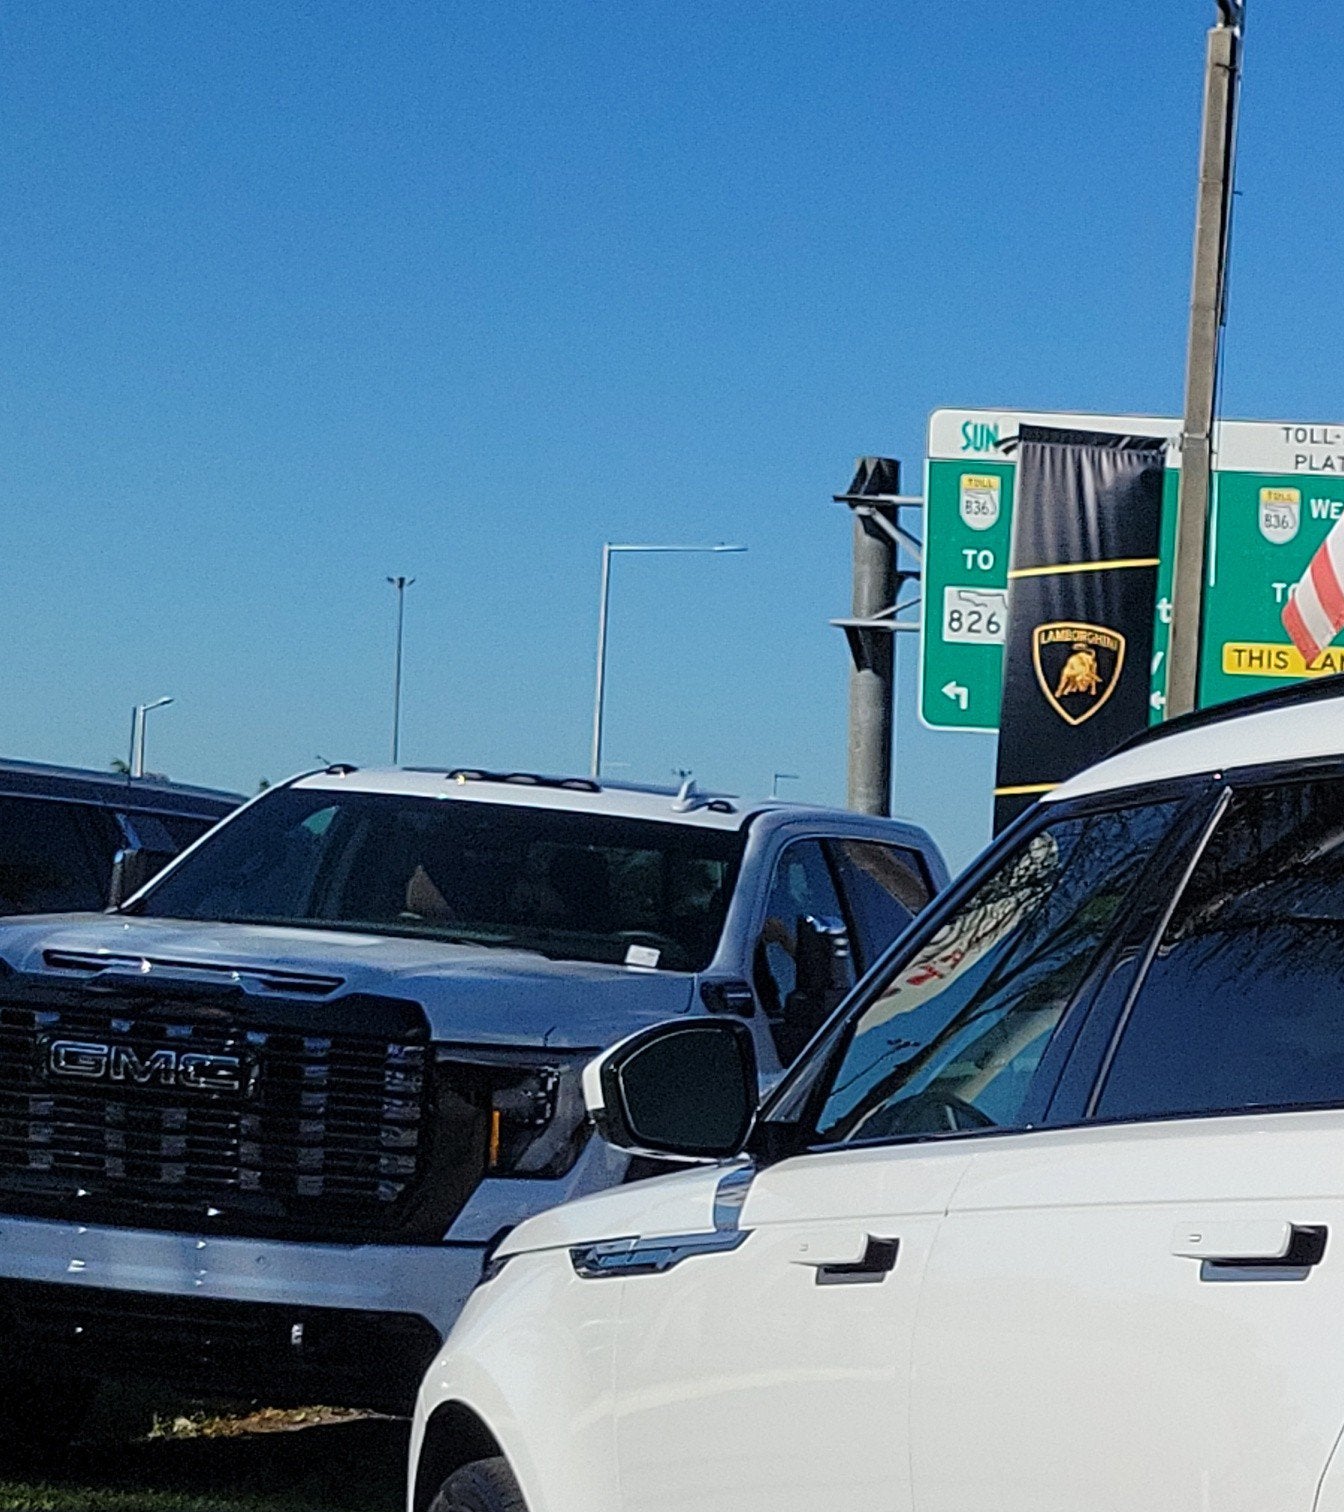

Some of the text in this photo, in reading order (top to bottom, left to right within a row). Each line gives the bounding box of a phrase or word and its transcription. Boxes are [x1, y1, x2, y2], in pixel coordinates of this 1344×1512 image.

[965, 500, 990, 515] 836
[962, 549, 994, 570] TO
[949, 609, 1001, 635] 826
[1234, 649, 1289, 670] THIS
[50, 1039, 241, 1090] GMC
